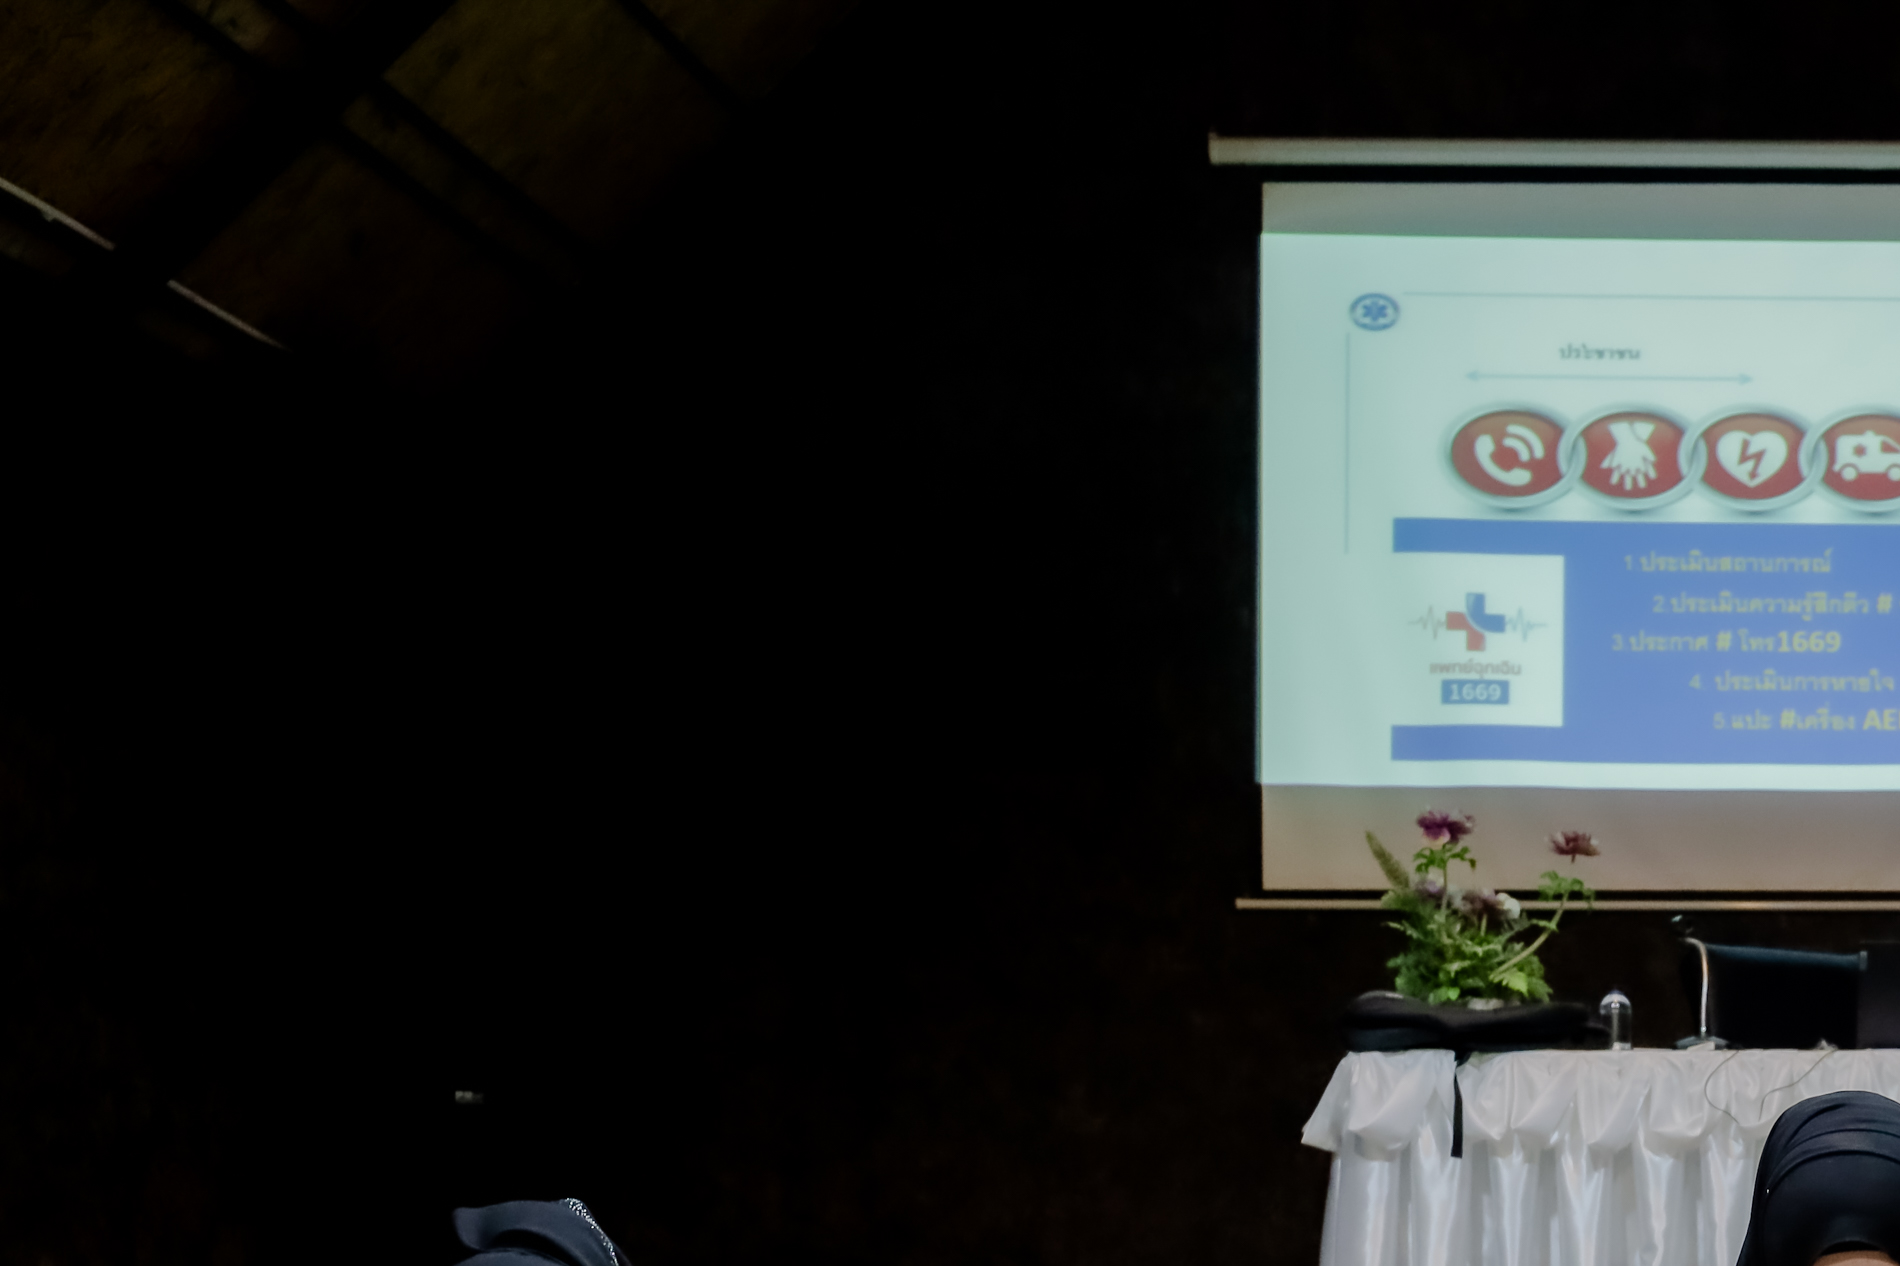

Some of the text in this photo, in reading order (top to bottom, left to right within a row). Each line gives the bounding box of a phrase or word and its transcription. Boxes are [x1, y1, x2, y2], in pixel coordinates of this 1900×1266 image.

[1429, 658, 1522, 679] แพทย์ฉุกเฉิน
[1450, 683, 1501, 700] 1669
